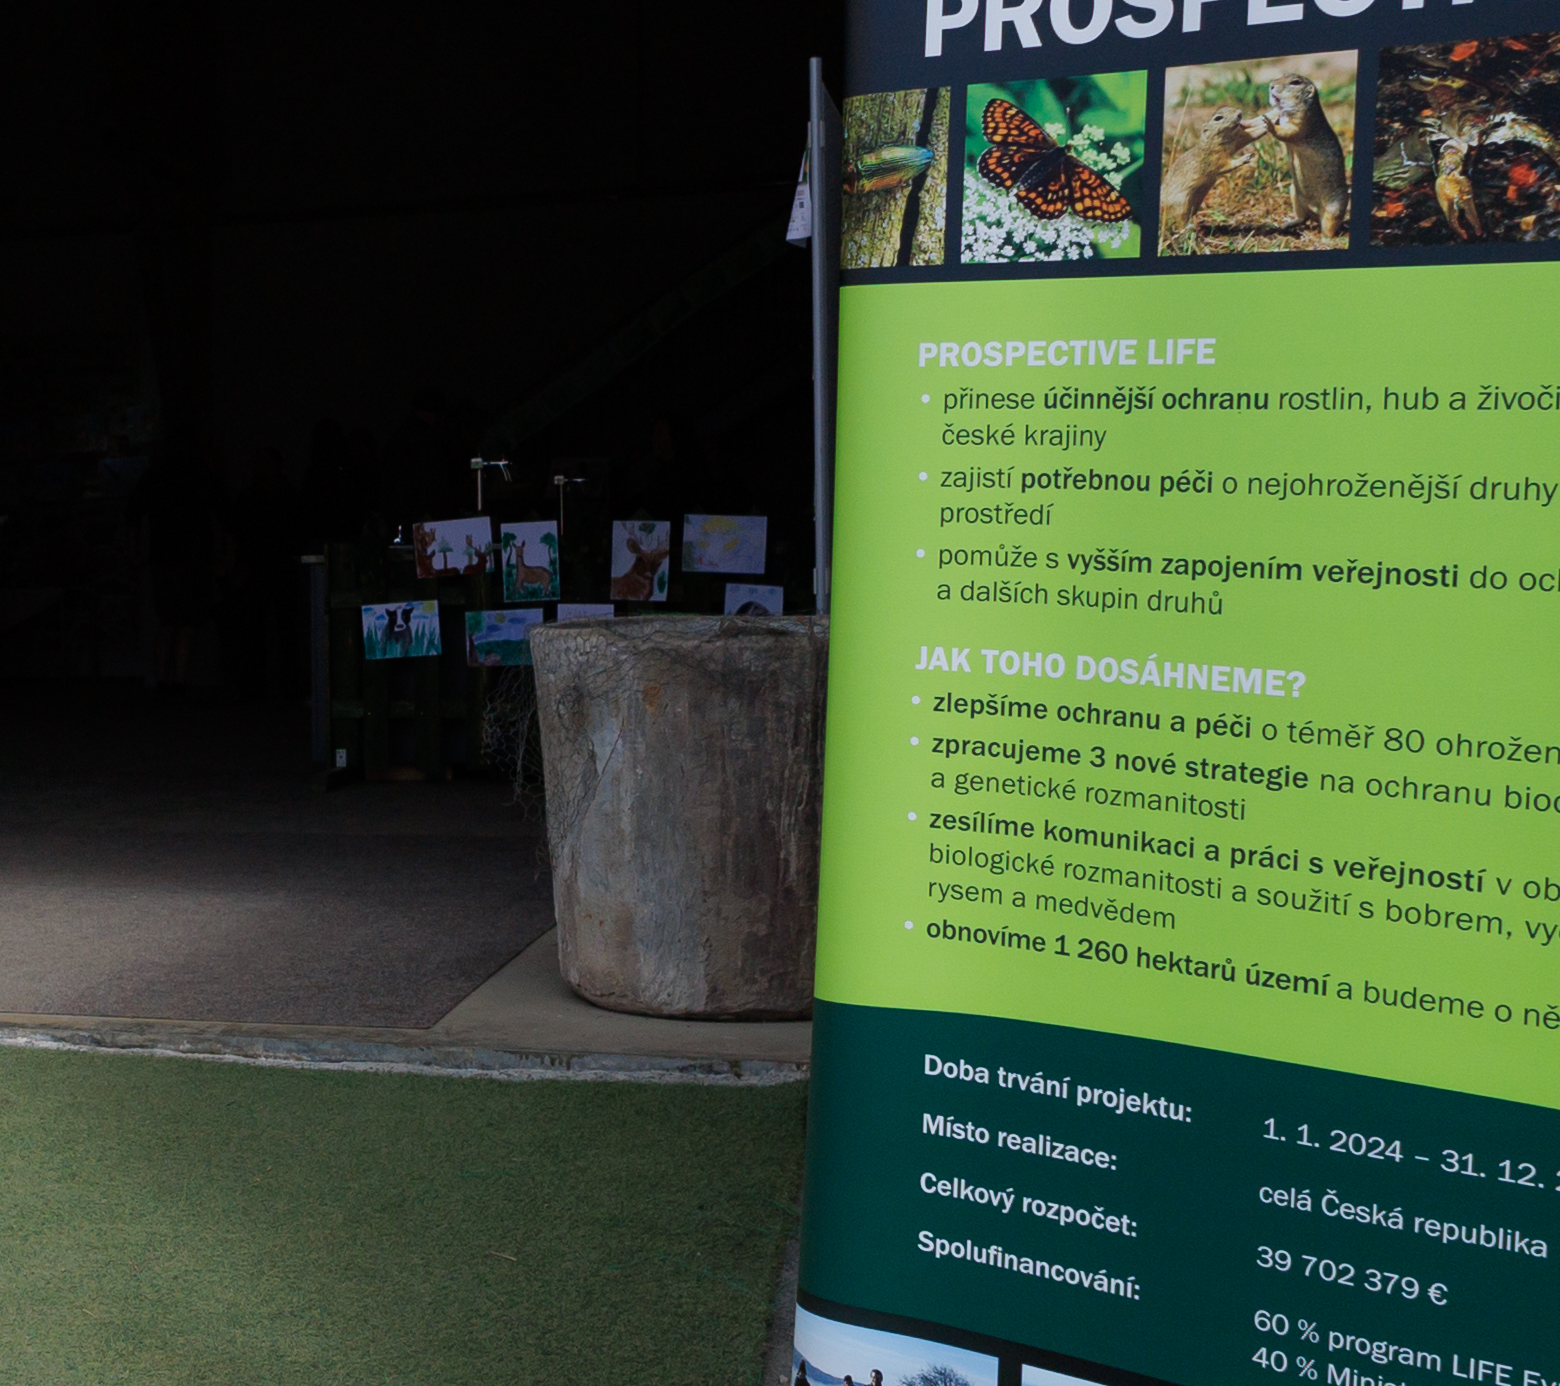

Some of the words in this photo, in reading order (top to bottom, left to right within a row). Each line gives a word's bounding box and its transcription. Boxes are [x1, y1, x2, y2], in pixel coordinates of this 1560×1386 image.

[918, 338, 1138, 368] PROSPECTIVE
[1147, 337, 1217, 366] LIFE
[943, 386, 1036, 415] přinese
[1043, 385, 1157, 415] účinnější
[1161, 386, 1269, 411] ochranu
[1278, 386, 1372, 415] rostlin,
[1383, 386, 1440, 411] hub
[1448, 391, 1466, 411] a
[941, 422, 1016, 446] české
[1024, 424, 1107, 452] krajiny
[940, 465, 1015, 493] zajistí
[1021, 466, 1151, 494] potřebnou
[1159, 468, 1213, 498] péči
[1222, 476, 1238, 495] o
[1247, 472, 1463, 505] nejohroženější
[1469, 475, 1559, 508] druhy
[940, 502, 1055, 528] prostředí
[938, 543, 1038, 570] pomůže
[1045, 552, 1060, 570] s
[1067, 547, 1152, 576] vyšším
[1160, 554, 1303, 583] zapojením
[1312, 558, 1459, 590] veřejnosti
[1469, 564, 1508, 590] do
[936, 583, 951, 601] a
[960, 579, 1049, 605] dalších
[1056, 584, 1138, 613] skupin
[1146, 589, 1223, 616] druhů
[914, 645, 972, 673] JAK
[980, 648, 1066, 679] TOHO
[1075, 654, 1307, 698] DOSÁHNEME?
[932, 691, 1049, 720] zlepšíme
[1056, 702, 1161, 731] ochranu
[1169, 715, 1186, 733] a
[1195, 712, 1252, 740] péči
[1261, 723, 1278, 741] o
[1286, 720, 1376, 749] téměř
[1383, 727, 1425, 754] 80
[930, 771, 945, 789] a
[953, 772, 1077, 801] genetické
[1085, 786, 1246, 821] rozmanitosti
[931, 737, 1082, 766] zpracujeme
[1089, 745, 1106, 768] 3
[1115, 752, 1177, 776] nové
[1184, 757, 1309, 792] strategie
[1320, 773, 1354, 794] na
[1365, 775, 1492, 807] ochranu
[929, 810, 1035, 839] zesílíme
[1043, 818, 1195, 859] komunikaci
[1203, 843, 1220, 862] a
[1230, 844, 1299, 872] práci
[1308, 856, 1324, 875] s
[1333, 856, 1487, 893] veřejností
[1495, 876, 1513, 896] v
[928, 881, 1003, 906] rysem
[1011, 891, 1026, 908] a
[1035, 894, 1176, 930] medvědem
[929, 842, 1055, 877] biologické
[1063, 862, 1222, 900] rozmanitosti
[1231, 884, 1247, 903] a
[1256, 887, 1353, 916] soužití
[1358, 900, 1375, 920] s
[1385, 898, 1512, 940] bobrem,
[926, 918, 1047, 953] obnovíme
[1053, 934, 1071, 957] 1
[1077, 937, 1129, 965] 260
[1136, 946, 1236, 983] hektarů
[1245, 962, 1332, 997] území
[1336, 981, 1353, 1001] a
[1363, 979, 1485, 1019] budeme
[1494, 1004, 1513, 1023] o
[1523, 1004, 1560, 1030] ně
[924, 1053, 990, 1085] Doba
[996, 1066, 1072, 1100] trvání
[1076, 1084, 1192, 1123] projektu:
[922, 1112, 991, 1144] Místo
[997, 1130, 1117, 1171] realizace:
[1263, 1117, 1286, 1142] 1.
[1296, 1123, 1320, 1148] 1.
[1329, 1129, 1404, 1163] 2024
[1440, 1149, 1486, 1178] 31.
[1497, 1159, 1545, 1189] 12.
[919, 1171, 1016, 1214] Celkový
[1022, 1196, 1137, 1238] rozpočet:
[1258, 1186, 1312, 1212] celá
[1321, 1188, 1404, 1230] Česká
[1413, 1216, 1548, 1259] republika
[917, 1230, 1140, 1301] Spolufinancování:
[1256, 1245, 1292, 1272] 39
[1301, 1254, 1356, 1287] 702
[1363, 1268, 1420, 1300] 379
[1427, 1282, 1448, 1306] €
[1251, 1346, 1288, 1373] 40
[1295, 1355, 1318, 1381] %
[1253, 1309, 1290, 1336] 60
[1297, 1318, 1320, 1344] %
[1328, 1330, 1442, 1372] program
